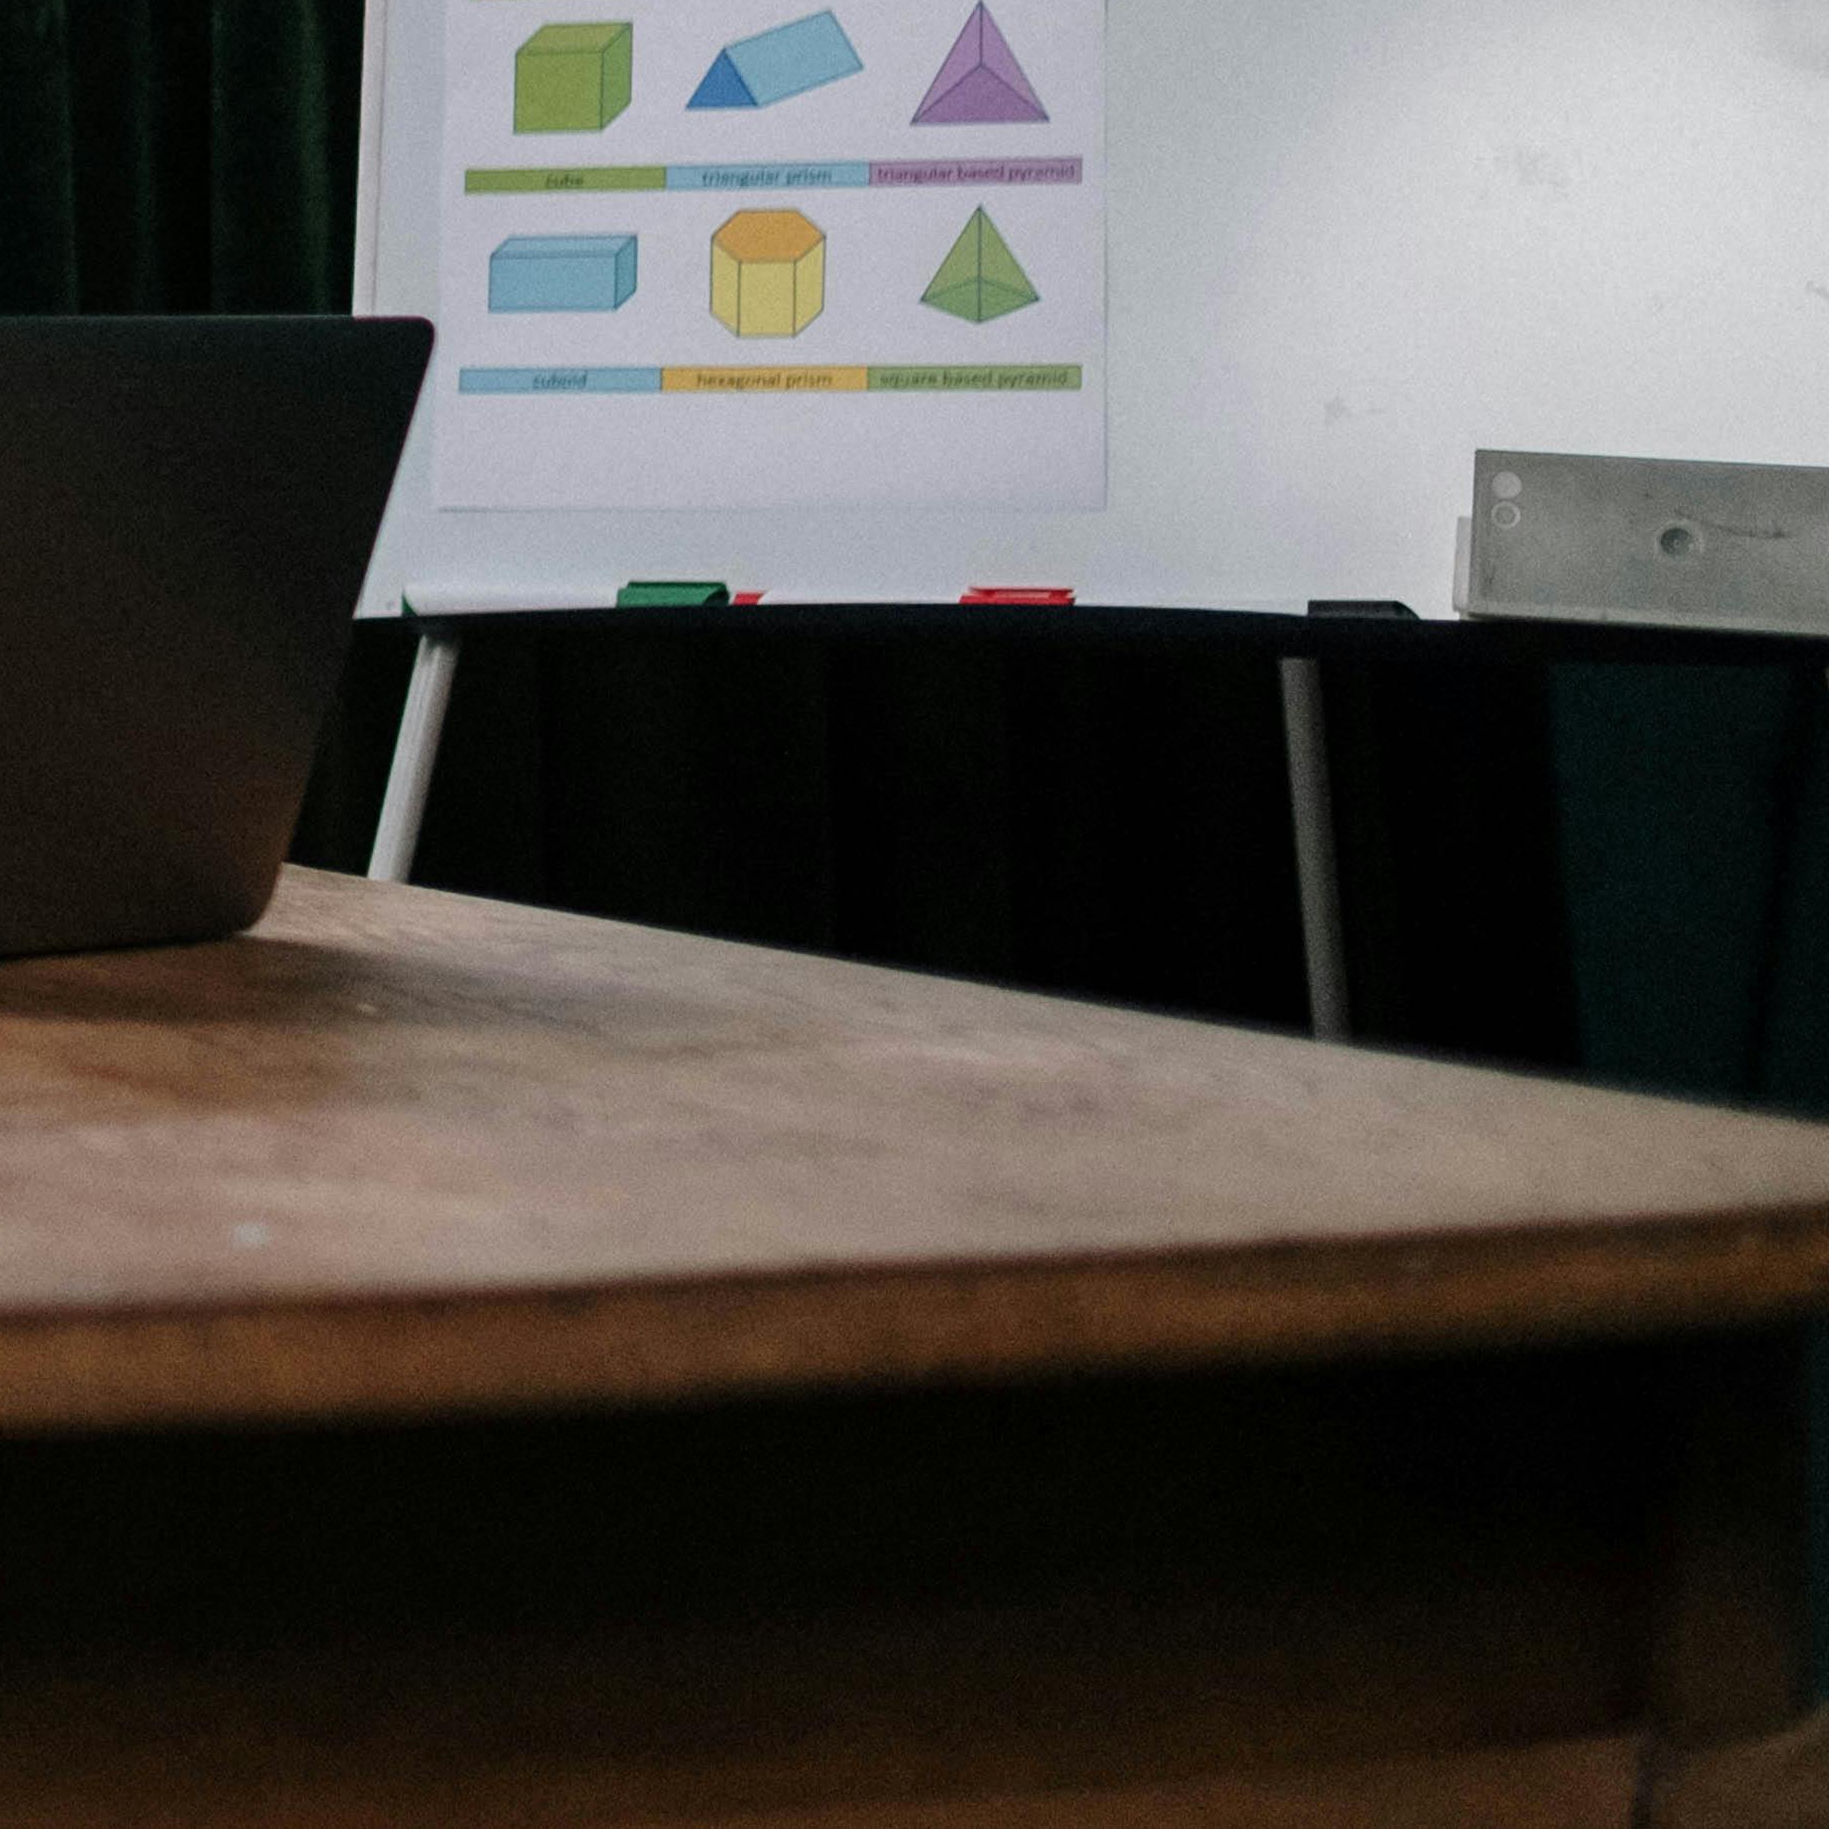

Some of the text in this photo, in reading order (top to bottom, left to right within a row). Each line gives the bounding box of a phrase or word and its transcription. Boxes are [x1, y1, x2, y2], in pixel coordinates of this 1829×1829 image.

[545, 173, 584, 188] cube
[702, 169, 833, 188] triangular prism
[877, 165, 1075, 184] triangular based pyramid
[533, 372, 588, 389] cuboid
[697, 372, 833, 391] hexagonal prism
[879, 370, 1068, 389] square based pyramid
